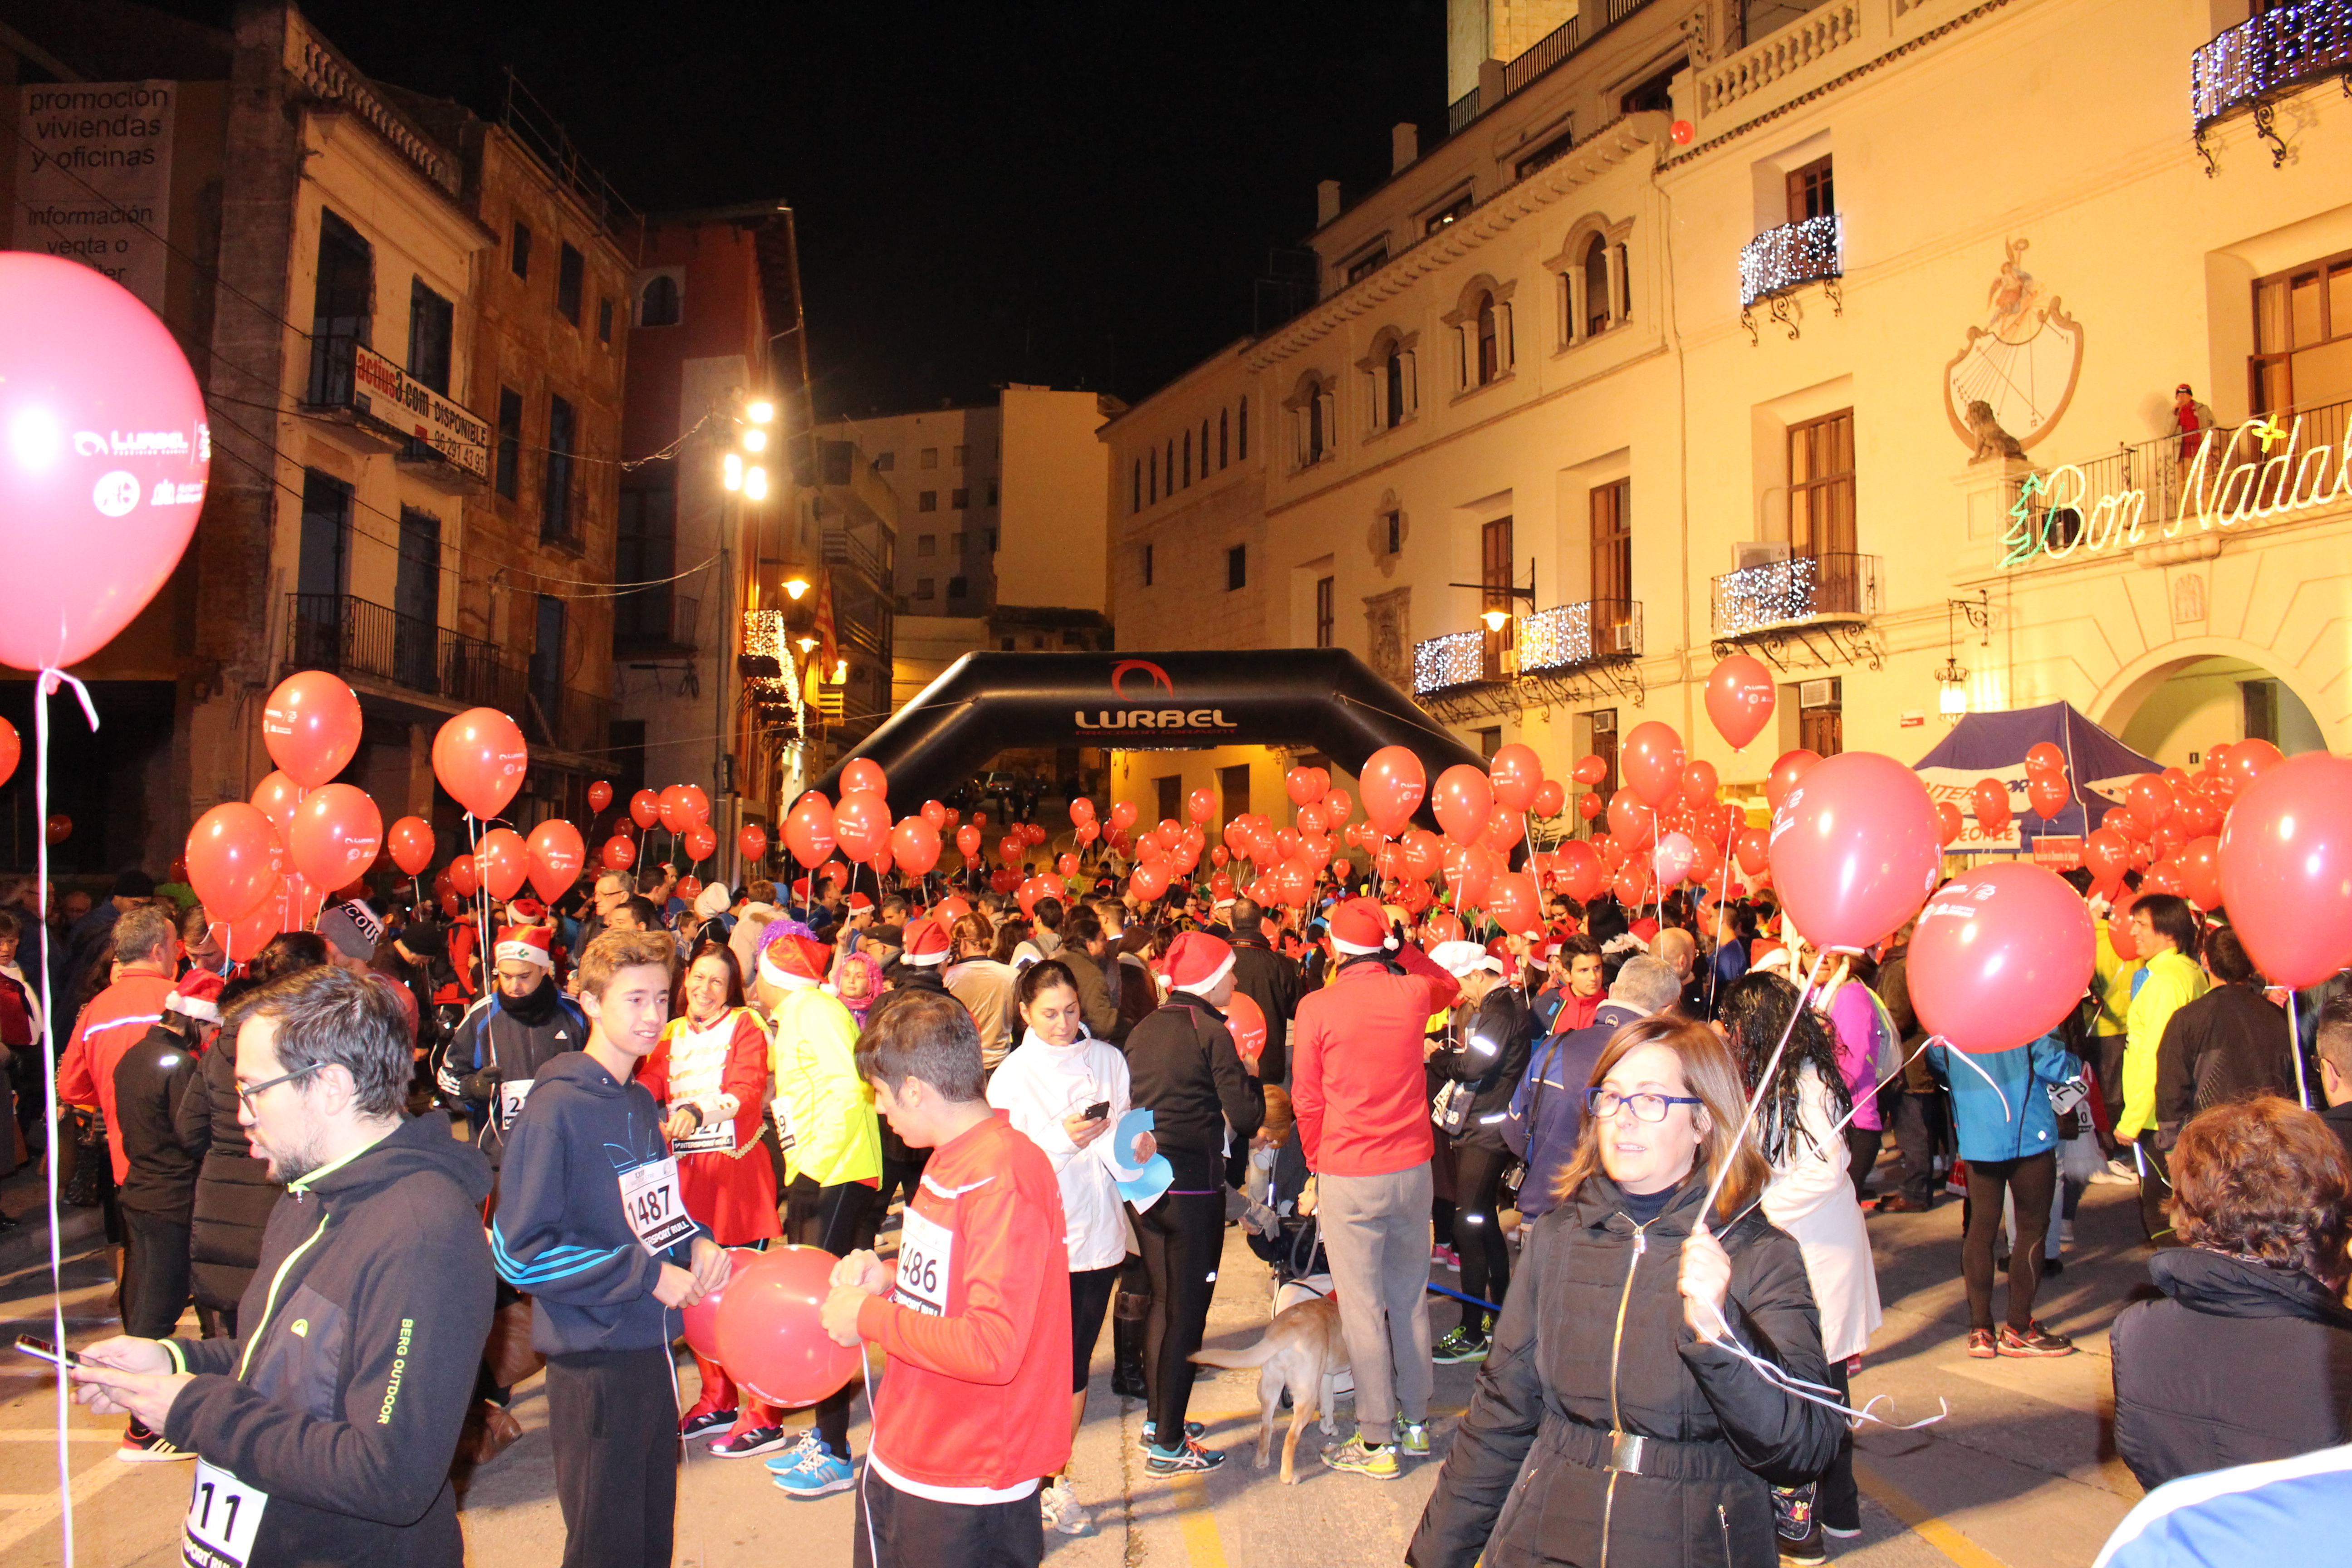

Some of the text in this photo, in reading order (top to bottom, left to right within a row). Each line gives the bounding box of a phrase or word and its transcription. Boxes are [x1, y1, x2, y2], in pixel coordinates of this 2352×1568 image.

[37, 115, 161, 139] viviendas
[31, 146, 155, 172] y oficinas
[47, 237, 128, 255] venta o
[434, 401, 486, 447] DISPONIBLE
[435, 431, 485, 473] 96 291 43 93
[2043, 464, 2145, 559] Bon
[1075, 709, 1237, 729] LURBEL
[680, 1138, 716, 1149] INTERSPORT
[627, 1184, 671, 1232] 1487
[670, 1220, 690, 1235] RULL
[897, 1241, 937, 1294] 1486
[377, 1318, 414, 1425] BERG OUTDOOR
[188, 1473, 241, 1544] 11
